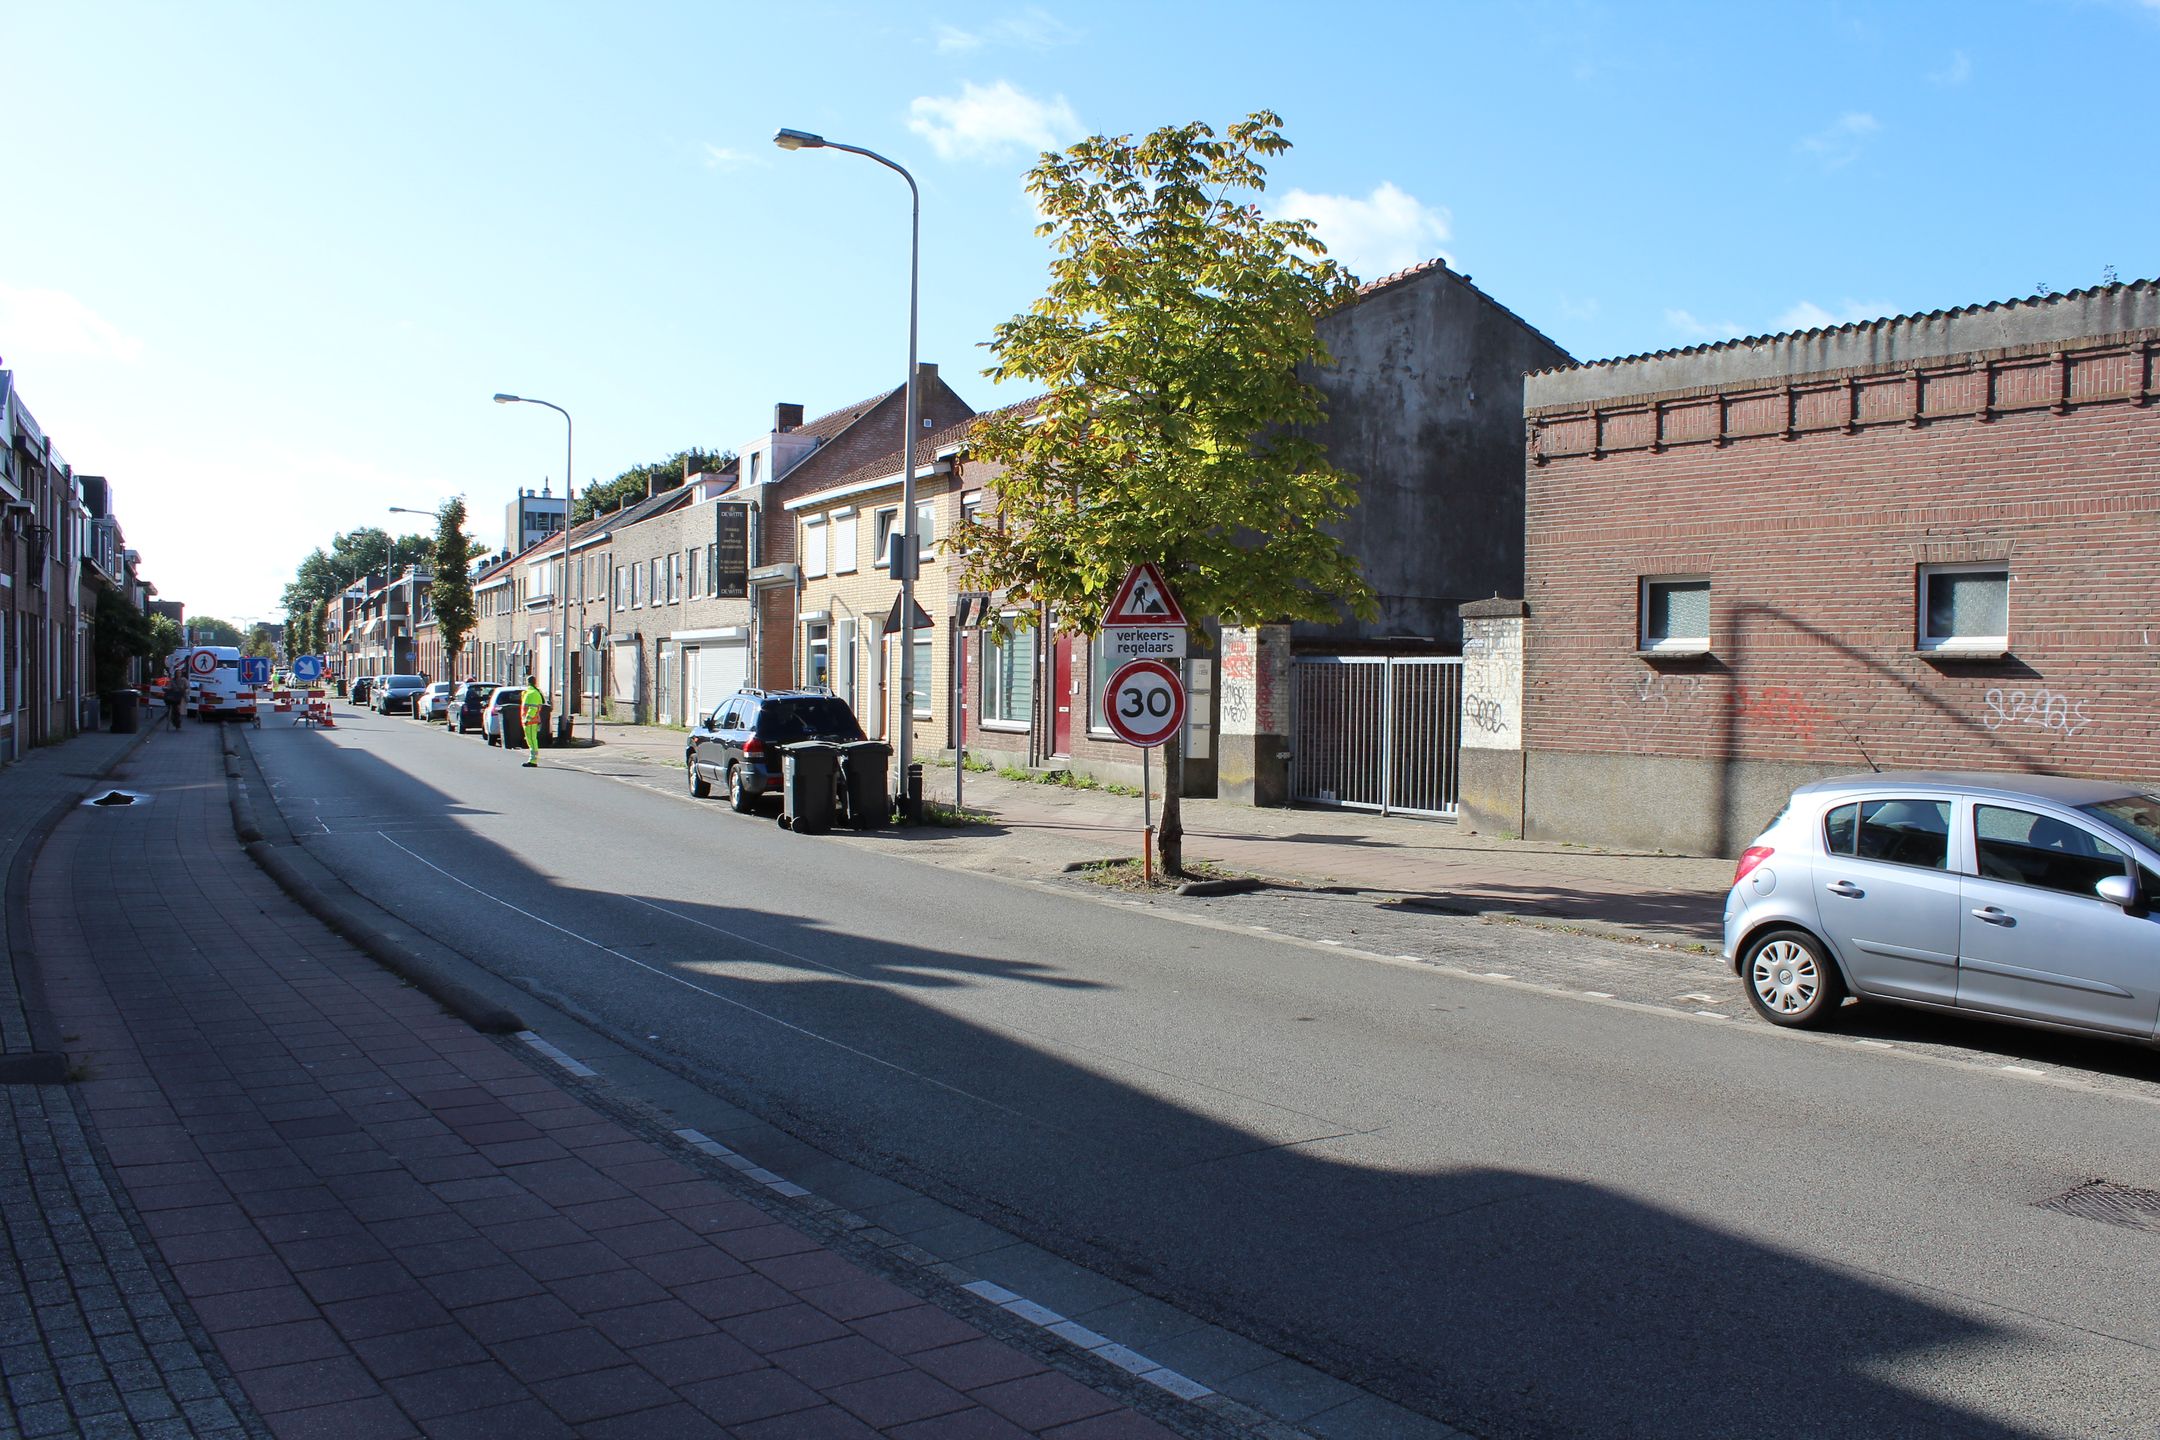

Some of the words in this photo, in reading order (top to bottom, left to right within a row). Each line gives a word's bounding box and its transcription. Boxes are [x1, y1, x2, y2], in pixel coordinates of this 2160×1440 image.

[1116, 630, 1175, 641] verkeers-
[1117, 641, 1174, 656] regelaars
[1120, 687, 1171, 718] 30
